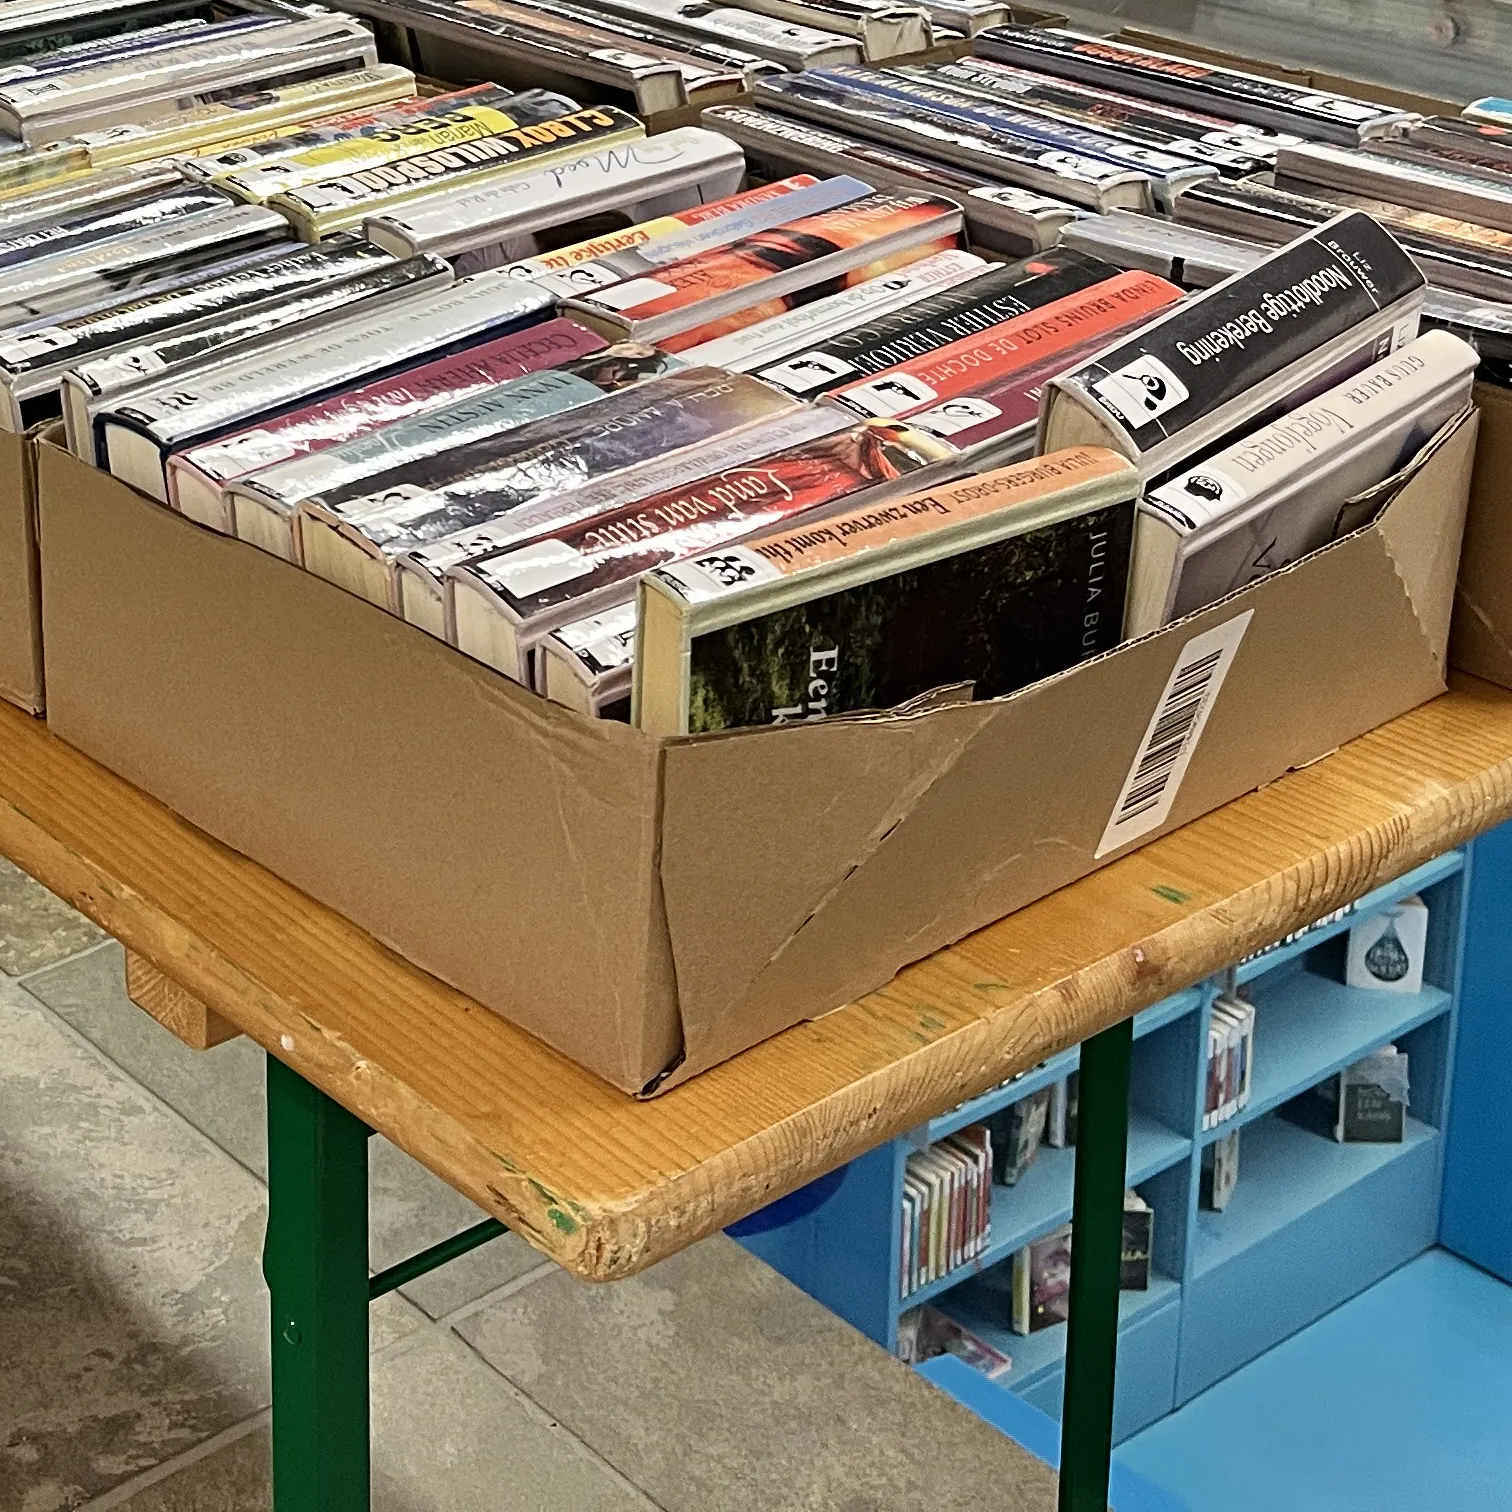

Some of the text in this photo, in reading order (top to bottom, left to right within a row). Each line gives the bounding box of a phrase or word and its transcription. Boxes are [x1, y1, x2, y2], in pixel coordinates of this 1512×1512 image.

[427, 119, 494, 145] Marian
[1326, 238, 1379, 294] Brouwer
[846, 294, 1030, 377] ESTHER VERHOEF
[916, 277, 1160, 385] LINDA BRUINS SLOT DE DOCHTE
[1174, 263, 1352, 367] Noodlottige Berekening
[488, 331, 578, 370] CECELIA
[416, 399, 505, 434] AUSTIN
[502, 375, 571, 403] LYNN
[1229, 353, 1425, 473] GUUS BAUER Vogeljongen
[653, 494, 716, 532] van
[706, 466, 793, 519] Land
[755, 450, 1096, 564] JULIA BURGERS-DROST Een zwerver komt thu
[1085, 530, 1107, 603] JULIA
[807, 644, 839, 723] Een
